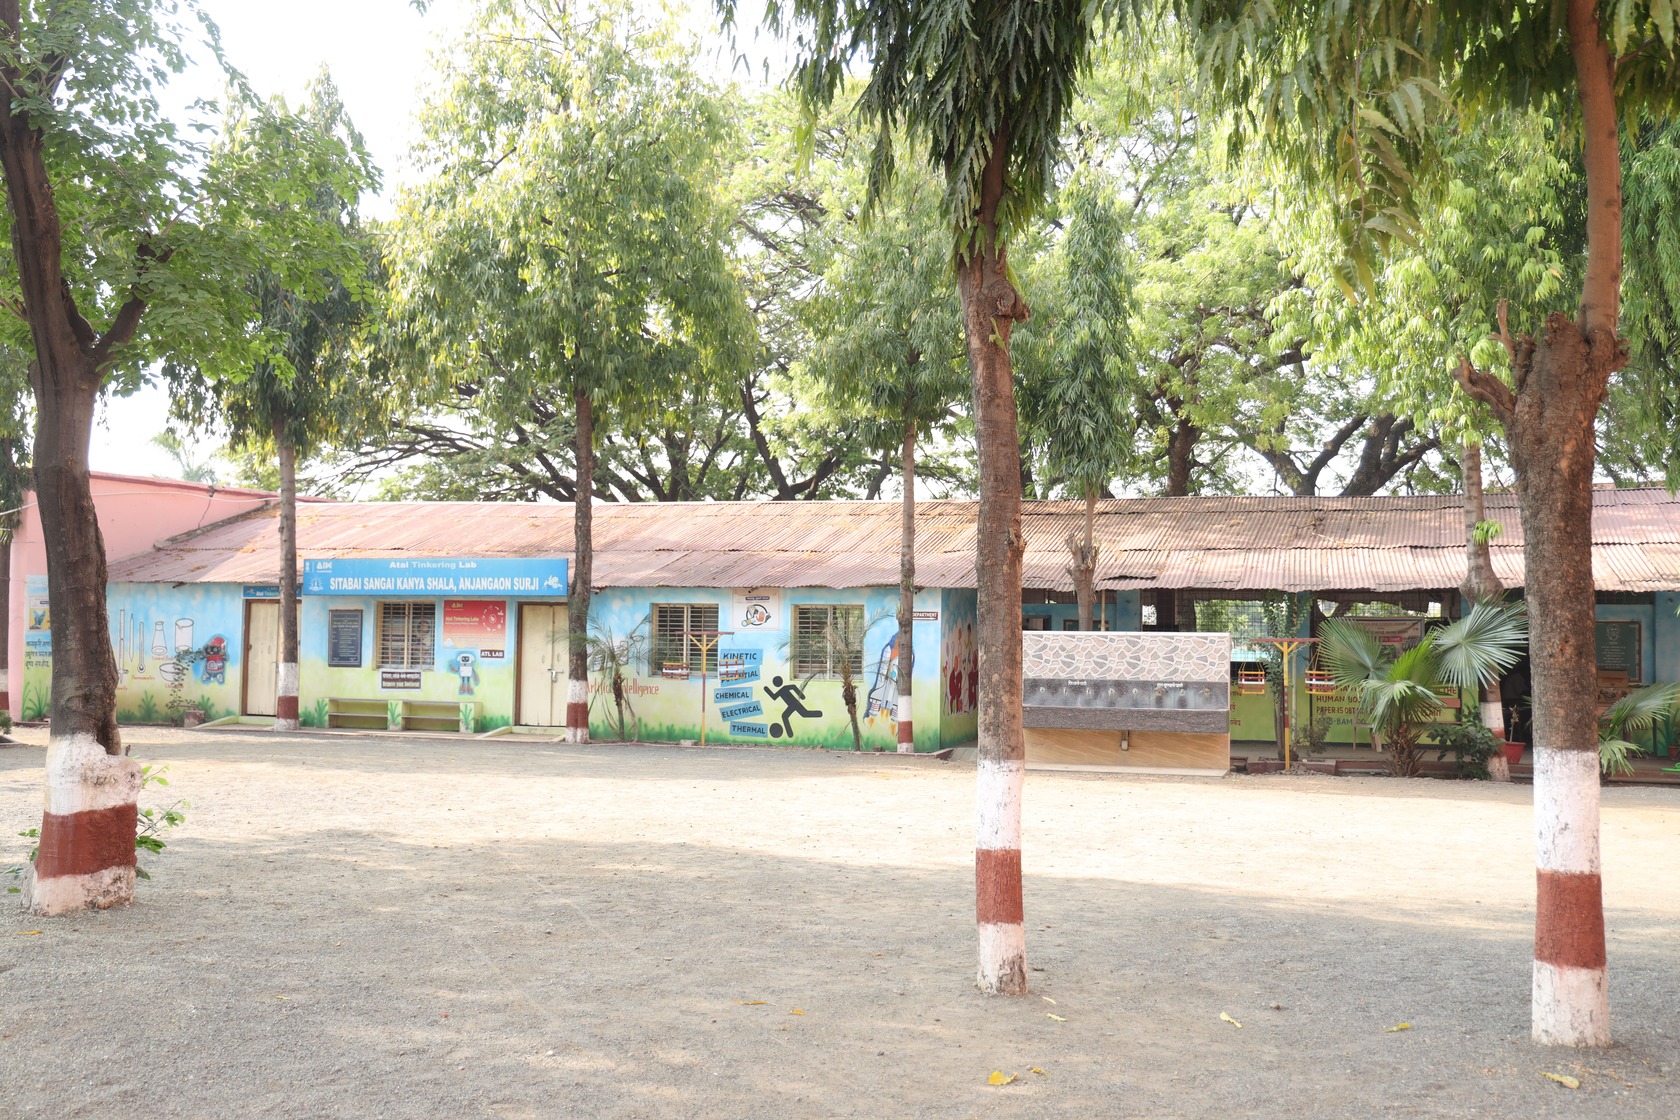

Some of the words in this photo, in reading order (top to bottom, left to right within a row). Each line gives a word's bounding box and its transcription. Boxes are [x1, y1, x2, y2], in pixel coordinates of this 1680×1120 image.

[389, 561, 409, 569] Atal
[411, 561, 457, 570] Tinkering
[458, 561, 477, 569] Lab
[330, 577, 362, 591] SITABAI
[363, 577, 395, 591] SANGAI
[396, 577, 425, 591] KANYA
[426, 577, 457, 593] SHALA,
[458, 577, 512, 591] ANJANGAON
[513, 577, 539, 591] SURJI
[723, 652, 758, 660] KINETIC
[721, 705, 761, 718] ELECTRICAL
[1337, 706, 1344, 714] IS
[732, 724, 765, 734] THERMAL
